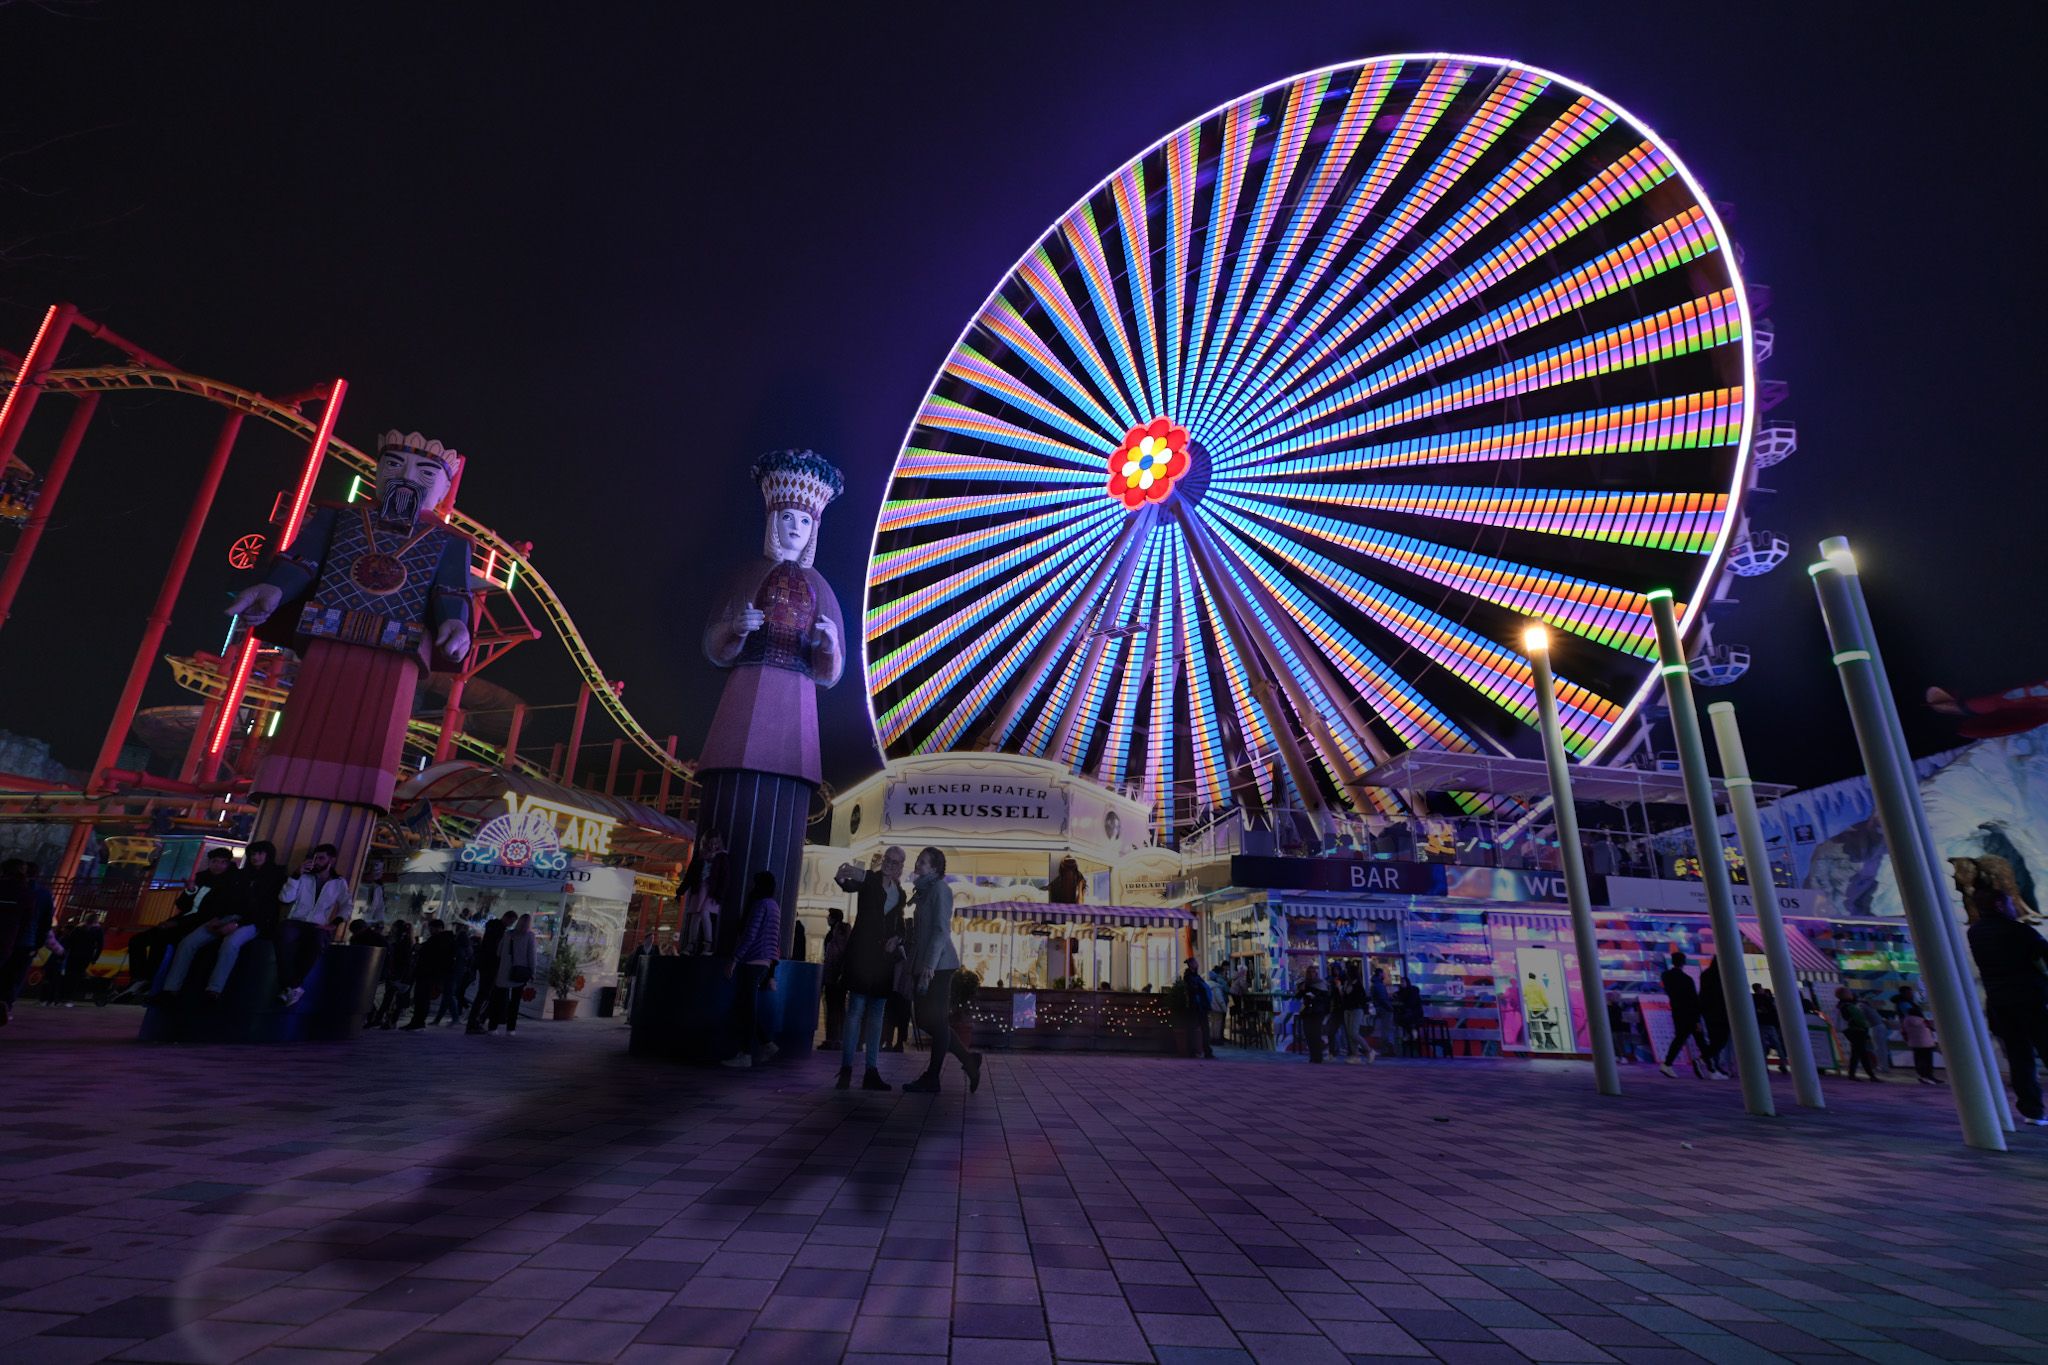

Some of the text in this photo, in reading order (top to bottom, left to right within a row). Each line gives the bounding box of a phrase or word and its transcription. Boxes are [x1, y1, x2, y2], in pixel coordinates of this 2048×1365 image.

[908, 784, 1047, 800] WIENER PRATER
[904, 803, 1049, 819] KARUSSELL
[503, 790, 622, 855] VOLARE
[454, 861, 591, 882] BLUMENRAD
[1350, 866, 1400, 890] BAR
